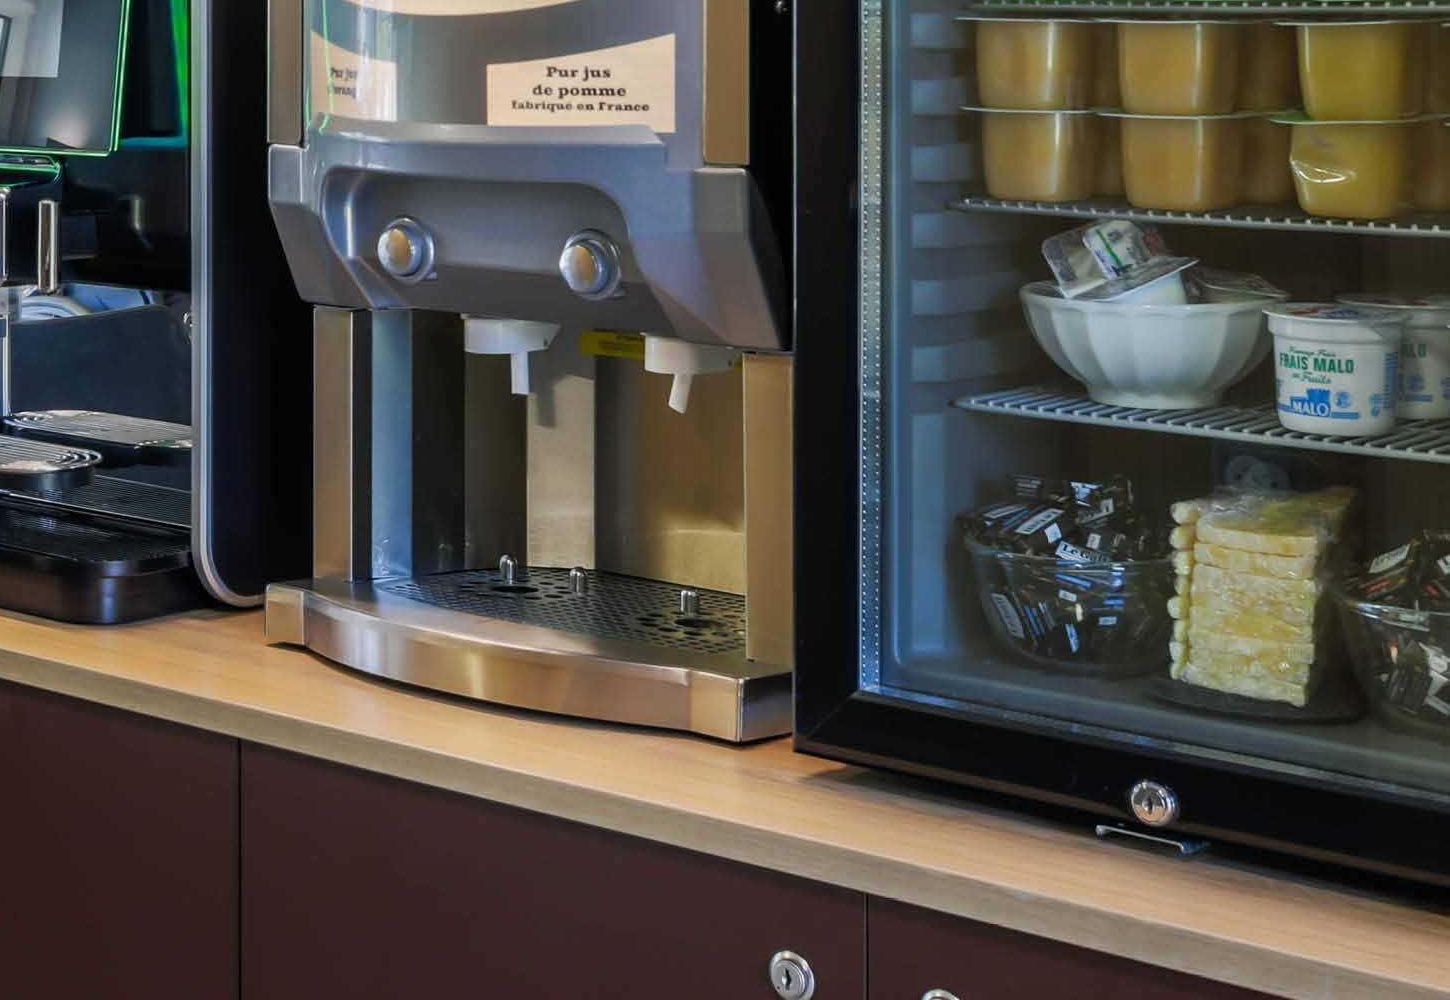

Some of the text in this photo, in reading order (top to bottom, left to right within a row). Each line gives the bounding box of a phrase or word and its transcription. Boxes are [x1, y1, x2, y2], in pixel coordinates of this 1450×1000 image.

[546, 66, 611, 81] Pur jus
[532, 84, 627, 99] de pomme
[511, 100, 650, 113] fabriqué en France
[1279, 352, 1355, 374] FRAIS MALO
[1291, 400, 1329, 417] MALO
